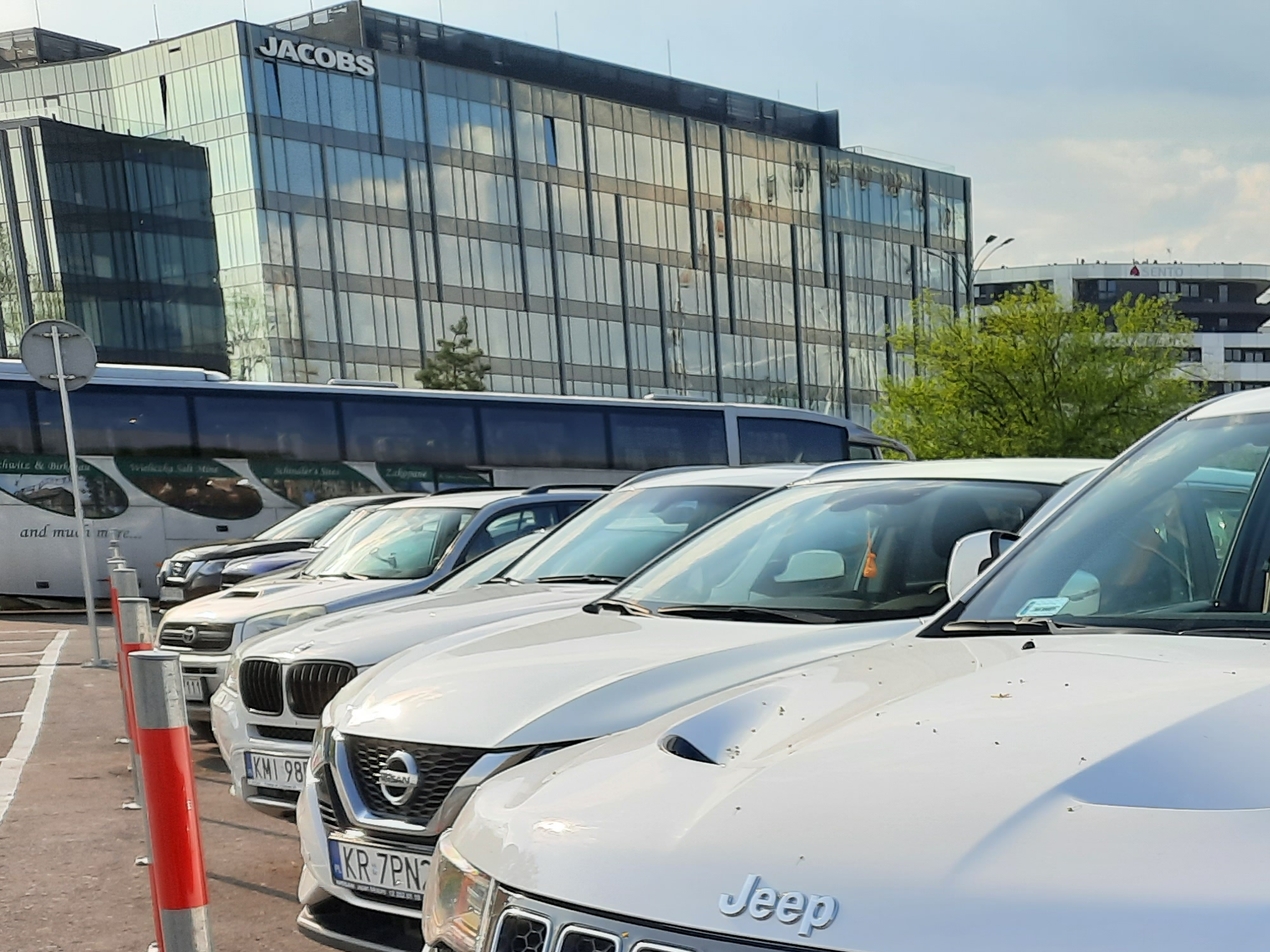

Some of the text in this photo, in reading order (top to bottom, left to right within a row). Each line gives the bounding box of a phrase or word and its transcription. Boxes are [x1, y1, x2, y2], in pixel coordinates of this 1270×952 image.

[260, 36, 375, 76] JACOBS
[1141, 266, 1184, 277] SENTO
[20, 524, 50, 537] and
[253, 756, 278, 781] KMI
[343, 846, 371, 882] KR
[719, 873, 839, 937] Jeep
